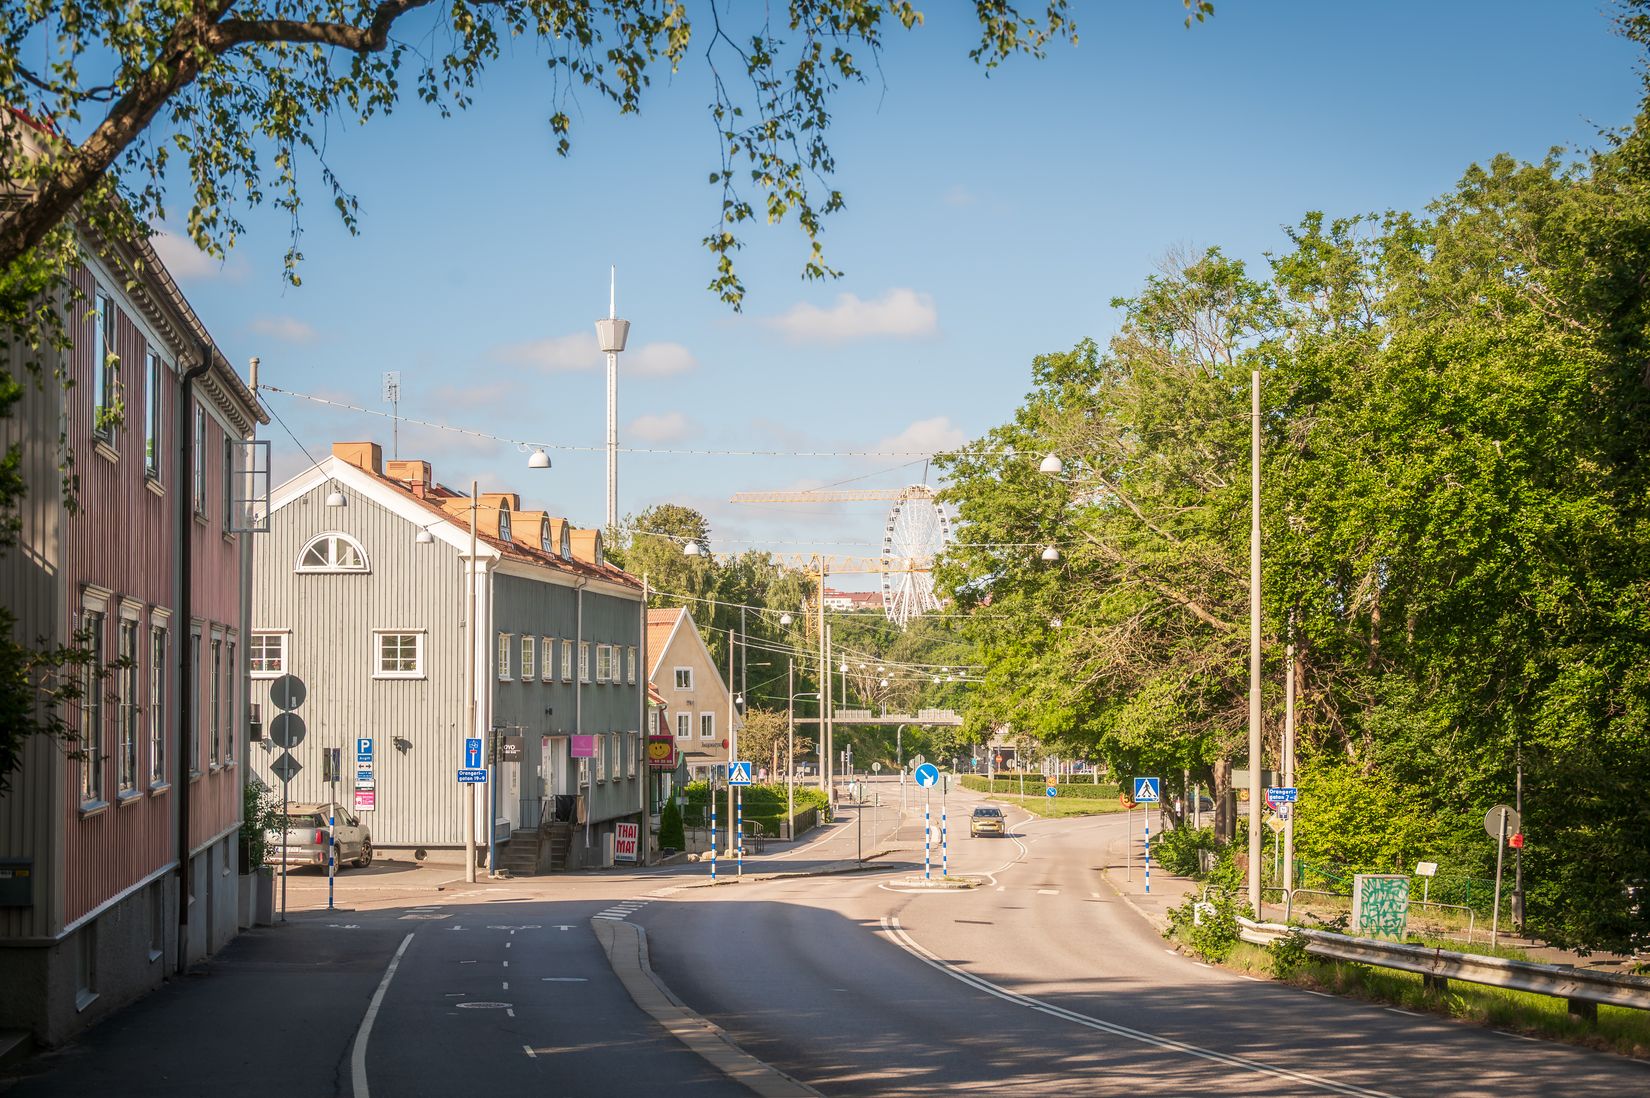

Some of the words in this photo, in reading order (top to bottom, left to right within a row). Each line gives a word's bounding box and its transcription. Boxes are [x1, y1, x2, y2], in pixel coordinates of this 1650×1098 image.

[361, 740, 370, 753] P
[617, 824, 637, 839] THAI
[616, 840, 636, 854] MAT
